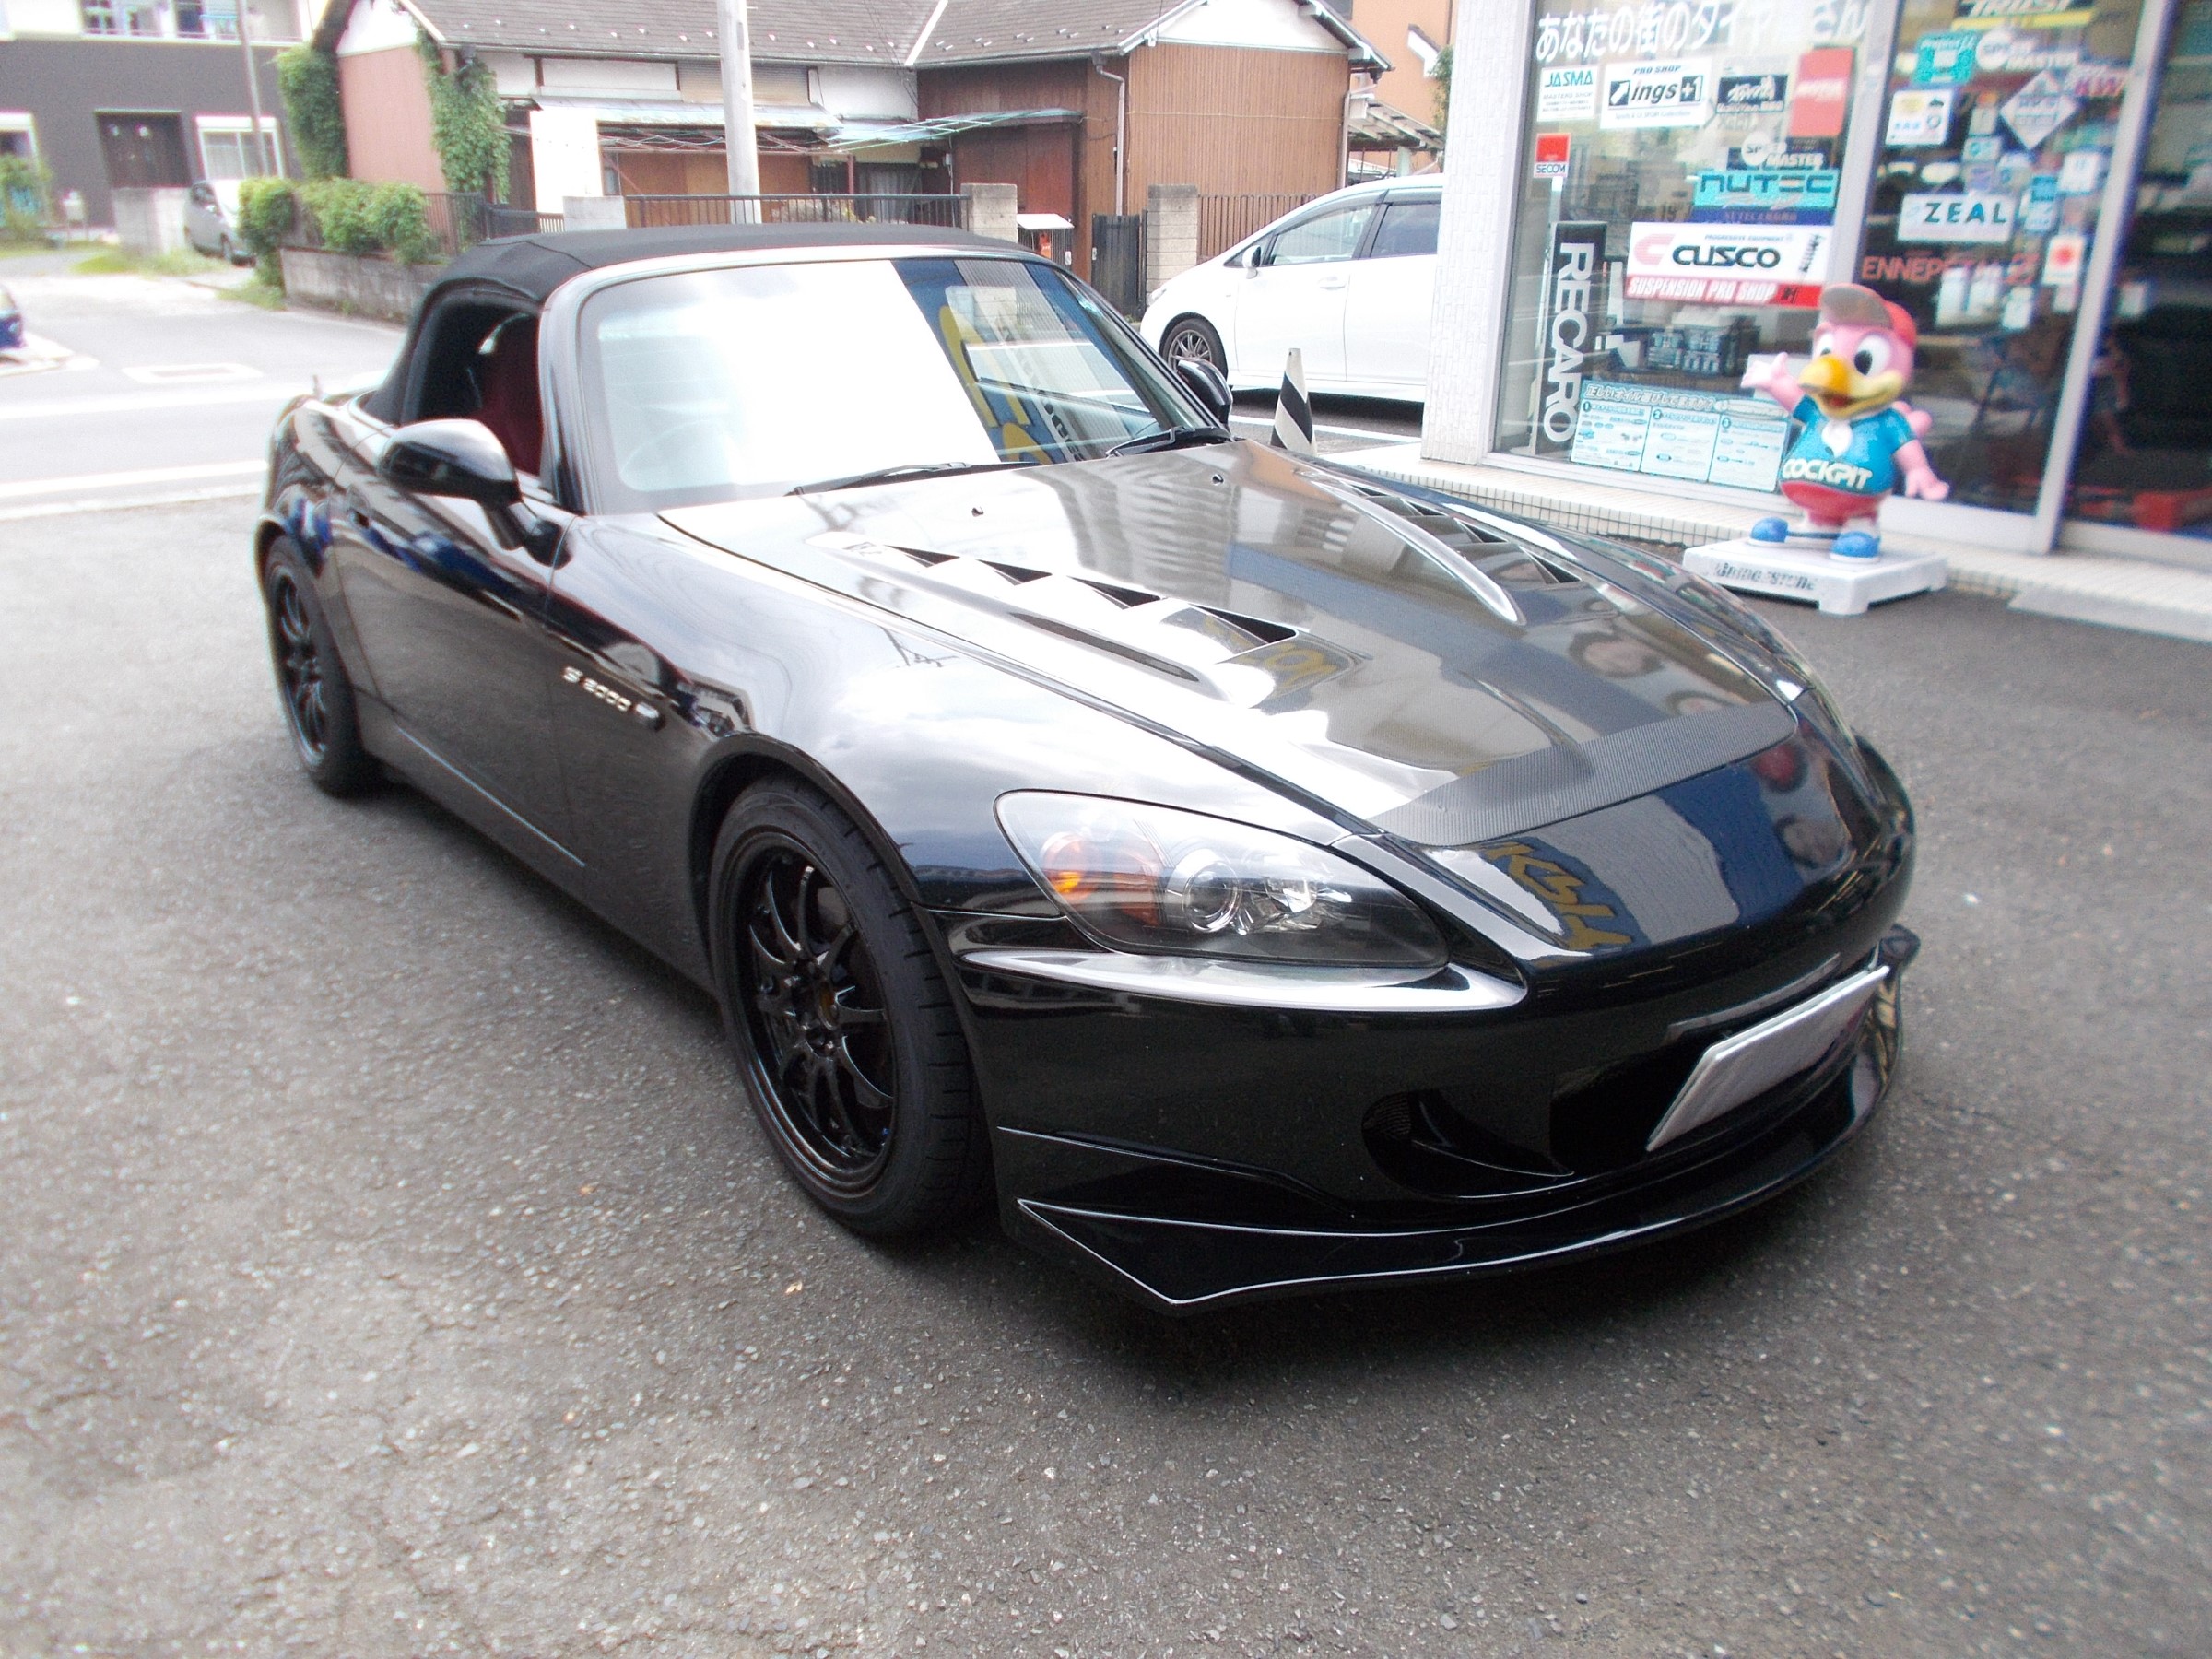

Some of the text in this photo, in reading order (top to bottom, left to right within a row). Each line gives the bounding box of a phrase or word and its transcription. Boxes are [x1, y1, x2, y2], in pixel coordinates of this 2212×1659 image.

[1536, 0, 1867, 63] あなたの街のタイヤさん
[1545, 70, 1593, 88] JASMA
[1536, 164, 1566, 173] SECOM
[1700, 174, 1834, 193] NUTEC
[1925, 202, 2007, 223] ZEAL
[1672, 244, 1781, 268] CUSCO
[1629, 276, 1707, 298] SUSPENSION
[1706, 279, 1735, 300] PRO
[1735, 281, 1778, 302] SHOP
[1543, 242, 1594, 442] RECARO
[1783, 458, 1873, 490] COCKPIT
